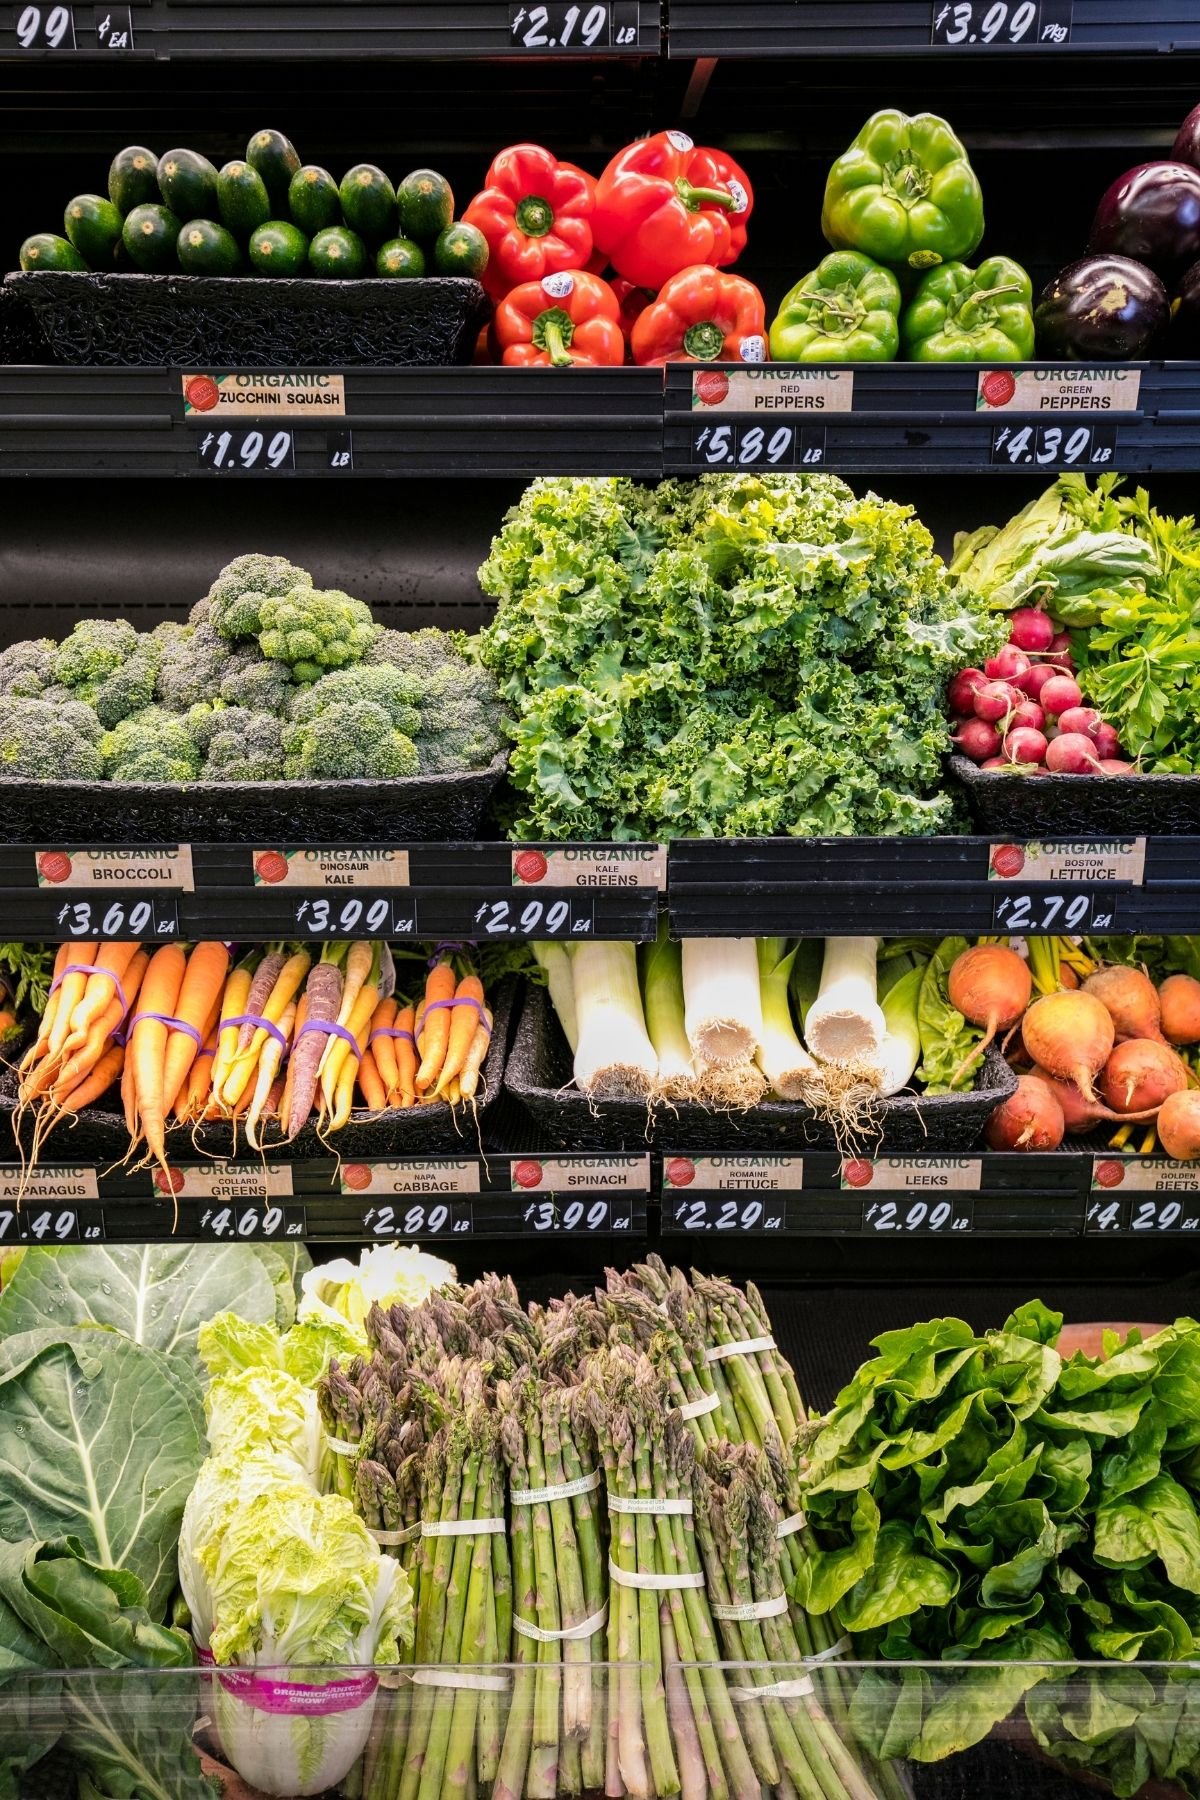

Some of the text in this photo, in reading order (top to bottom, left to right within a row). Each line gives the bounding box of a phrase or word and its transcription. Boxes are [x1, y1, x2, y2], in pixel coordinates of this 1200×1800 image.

[17, 6, 69, 48] 99
[108, 32, 128, 48] EA
[511, 5, 636, 47] $2.19 LB
[935, 1, 1068, 43] $3.99 Pkg
[236, 375, 330, 387] ORGANIC
[746, 370, 840, 380] ORGANIC
[1033, 370, 1128, 381] ORGANIC
[780, 385, 800, 393] RED
[1059, 386, 1092, 394] GREEN
[220, 392, 281, 404] ZUCCHINI
[287, 393, 340, 405] SQUASH
[754, 395, 825, 409] PEPPERS
[1040, 396, 1111, 409] PEPPERS
[200, 431, 349, 468] $1.99 LB
[694, 426, 822, 463] $5.89 LB
[994, 426, 1112, 464] $4.39 LB
[1042, 843, 1133, 854] ORGANIC
[87, 850, 178, 860] ORGANIC
[304, 850, 396, 862] ORGANIC
[563, 849, 655, 862] ORGANIC
[320, 863, 369, 871] DINOSAUR
[595, 865, 619, 873] KALE
[1064, 859, 1104, 867] BOSTON
[92, 868, 172, 880] BROCCOLI
[324, 875, 354, 885] KALE
[1050, 868, 1117, 880] LETTUCE
[576, 874, 639, 887] GREENS
[295, 899, 413, 933] $3.99 EA
[474, 901, 590, 934] $2.99 EA
[996, 895, 1113, 929] $2.79 EA
[57, 902, 175, 935] $3.69 EA
[387, 1161, 468, 1171] ORGANIC
[557, 1157, 638, 1168] ORGANIC
[710, 1157, 792, 1168] ORGANIC
[888, 1158, 971, 1169] ORGANIC
[568, 1175, 627, 1185] SPINACH
[719, 1179, 779, 1189] LETTUCE
[905, 1175, 949, 1186] LEEKS
[1155, 1181, 1199, 1190] BEETS
[3, 1185, 86, 1196] ASPARAGUS
[211, 1186, 267, 1196] GREENS
[393, 1181, 459, 1192] CABBAGE
[362, 1204, 470, 1234] $2.89 LB
[522, 1201, 630, 1231] $3.99 EA
[674, 1200, 781, 1230] $2.29 EA
[865, 1201, 969, 1231] $2.99 LB
[200, 1207, 303, 1236] $4.69 EA
[1181, 1218, 1200, 1229] EA
[84, 1226, 101, 1238] LB
